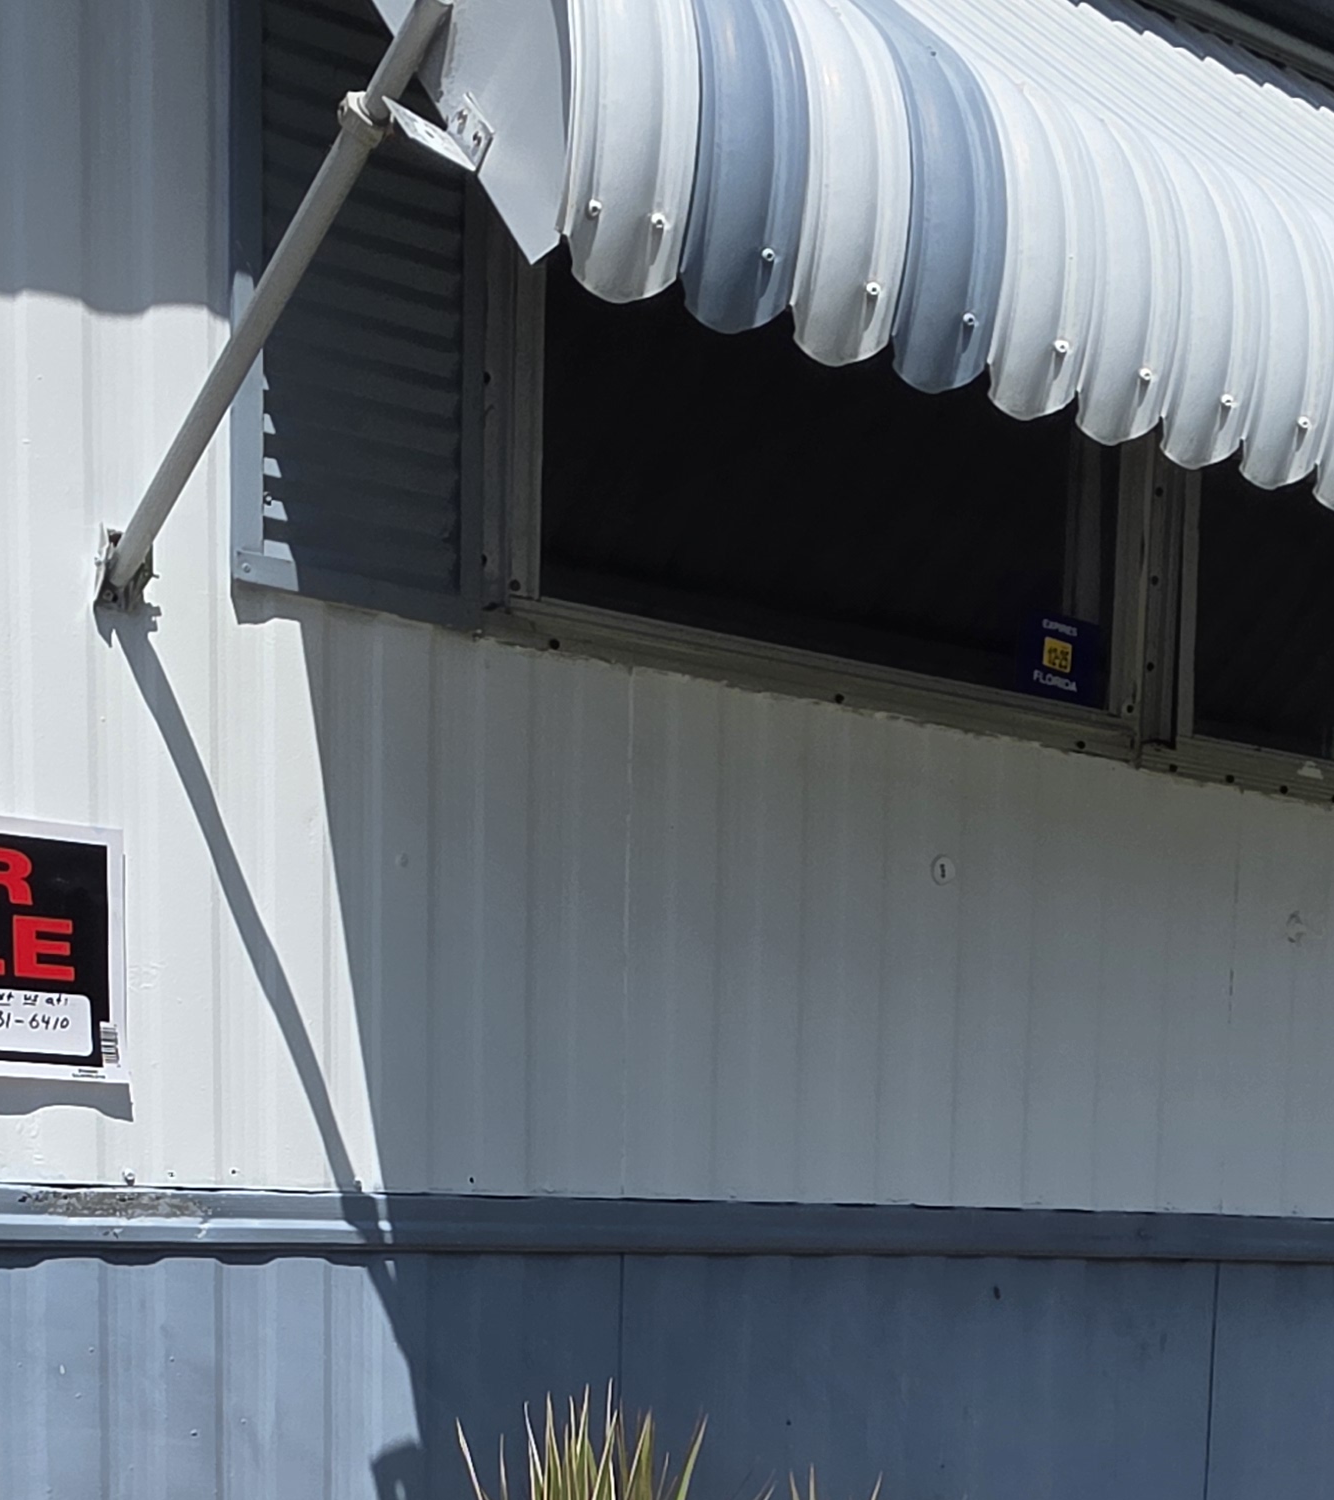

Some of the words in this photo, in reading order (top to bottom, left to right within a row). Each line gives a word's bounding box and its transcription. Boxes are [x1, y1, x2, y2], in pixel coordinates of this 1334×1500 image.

[1042, 618, 1078, 637] EXPIRES
[1033, 669, 1078, 693] FLORIDA
[23, 993, 39, 1003] us
